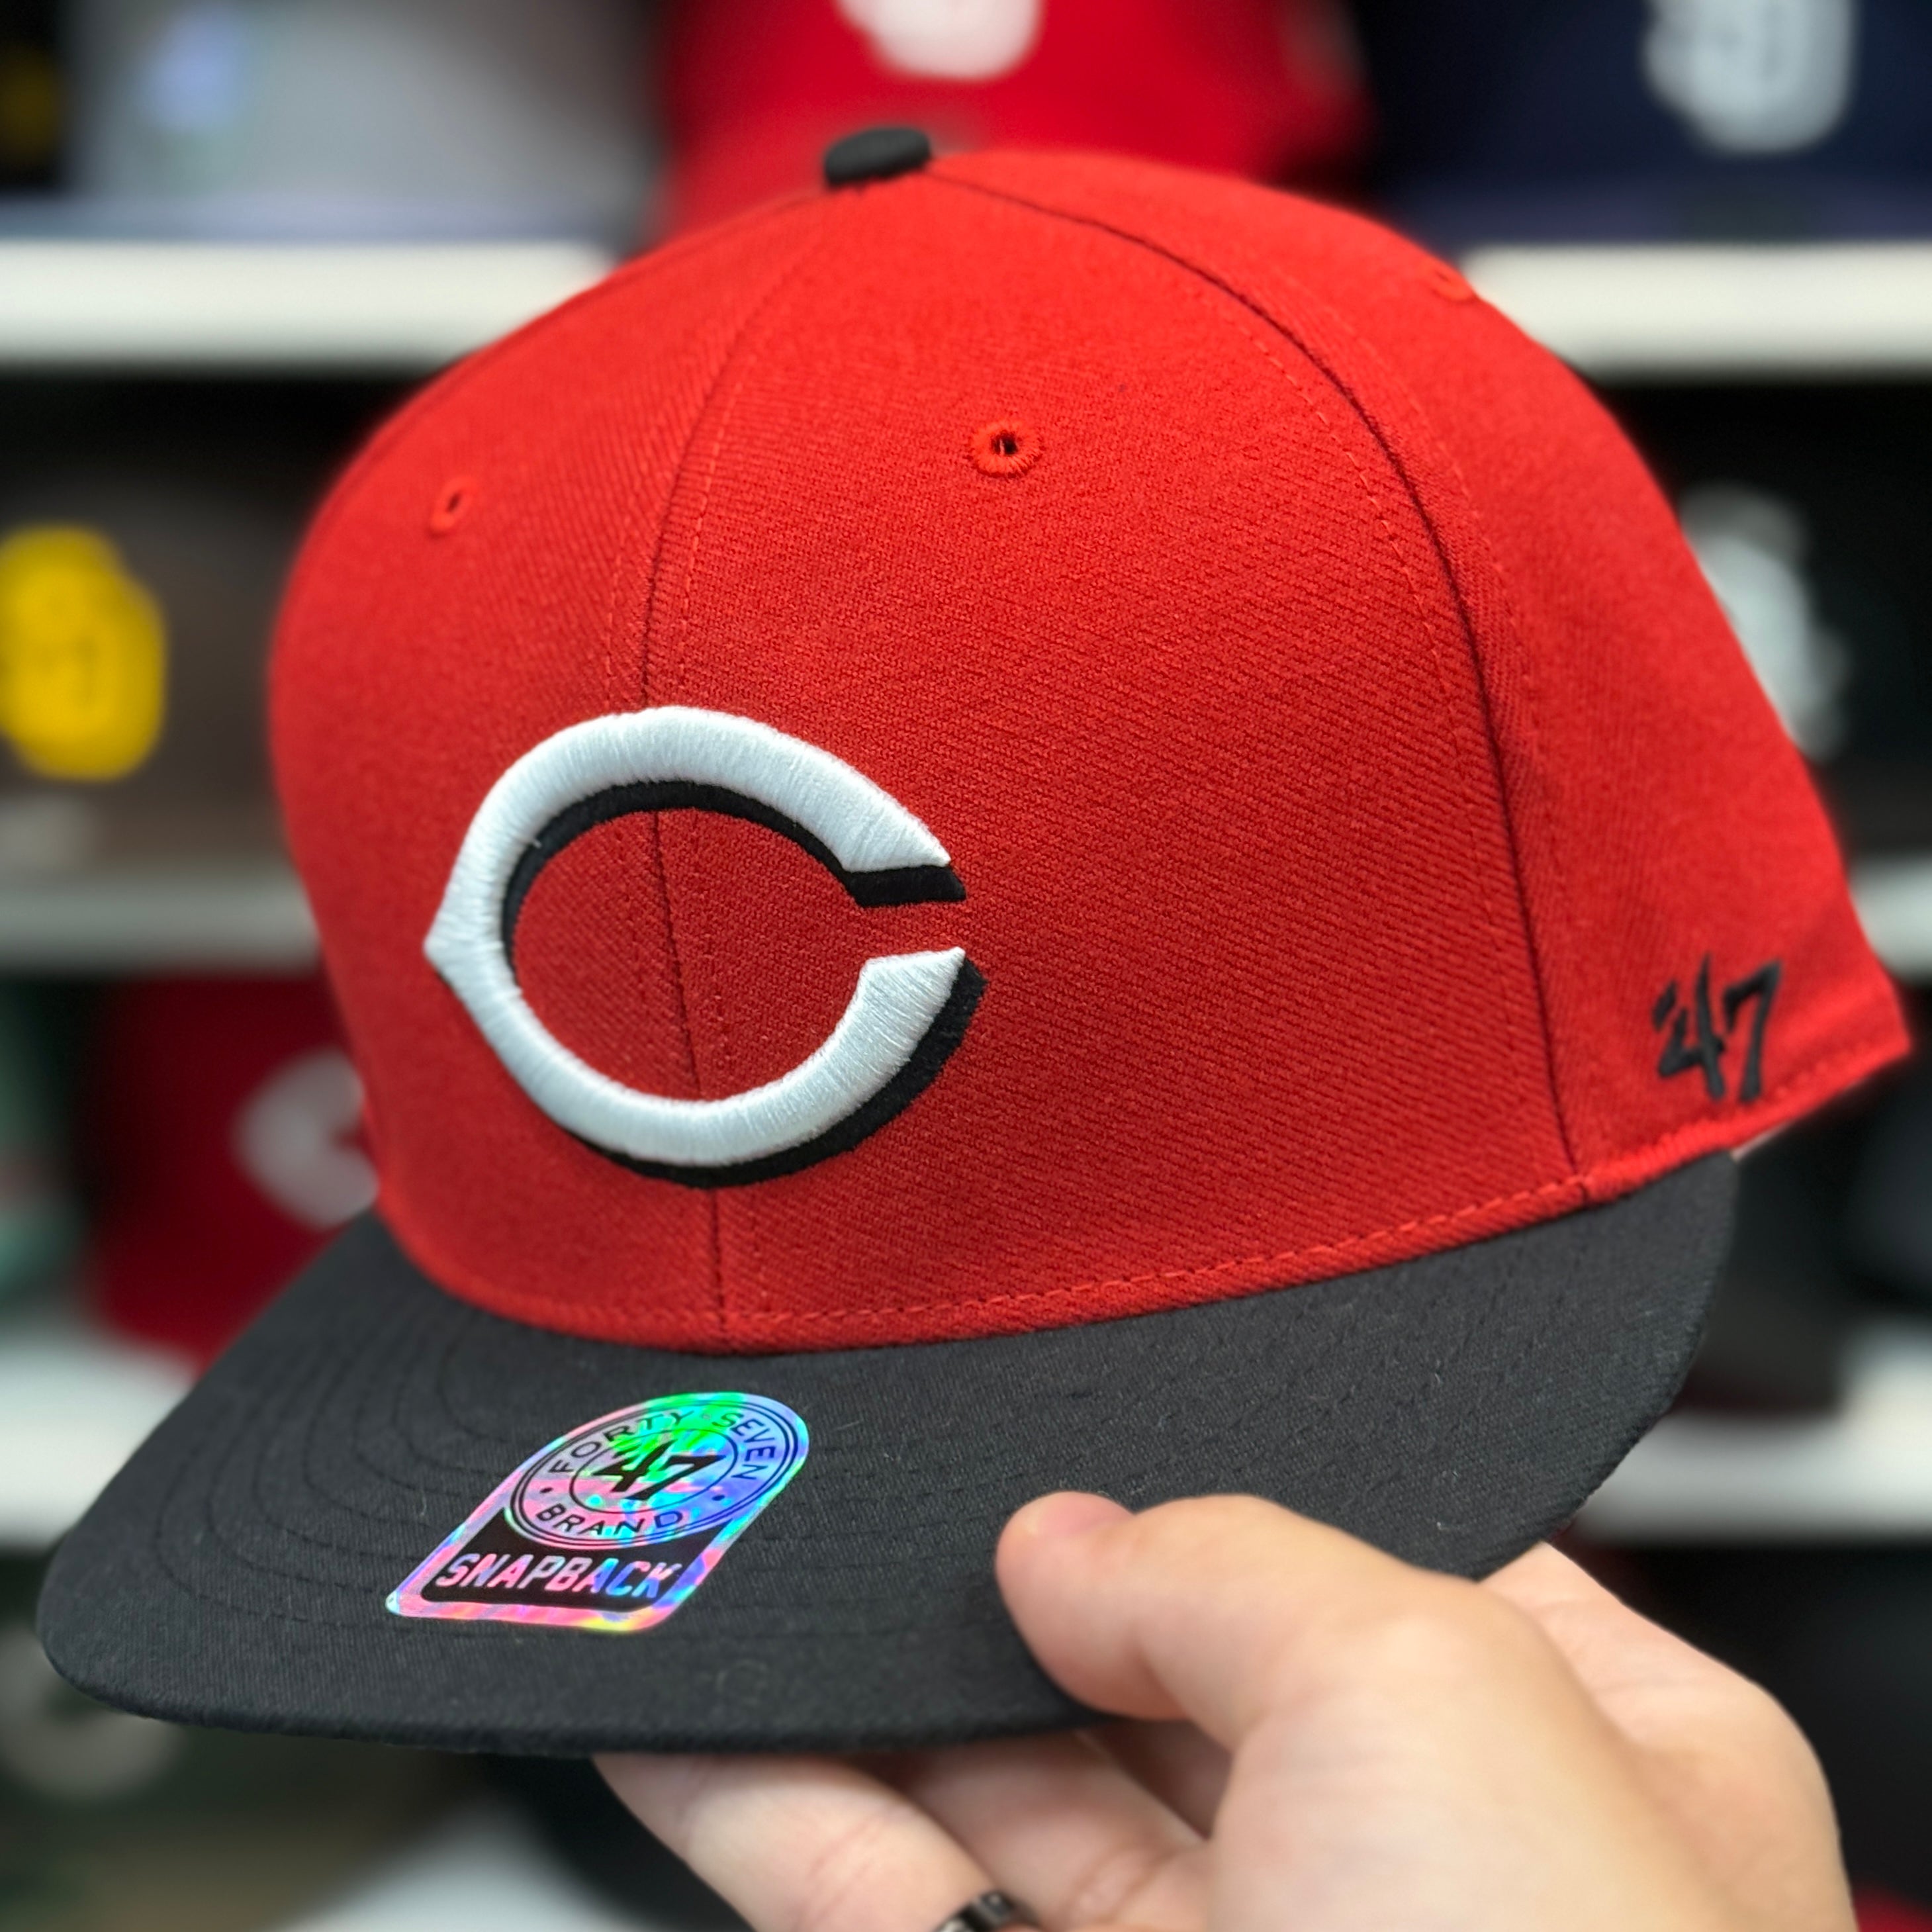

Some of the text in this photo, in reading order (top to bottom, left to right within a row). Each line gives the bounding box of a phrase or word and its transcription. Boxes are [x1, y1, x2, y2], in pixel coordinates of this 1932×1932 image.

[548, 1410, 778, 1481] FORTY SEVEN
[535, 1503, 684, 1536] BRAND
[435, 1552, 682, 1599] SNAPBACK
